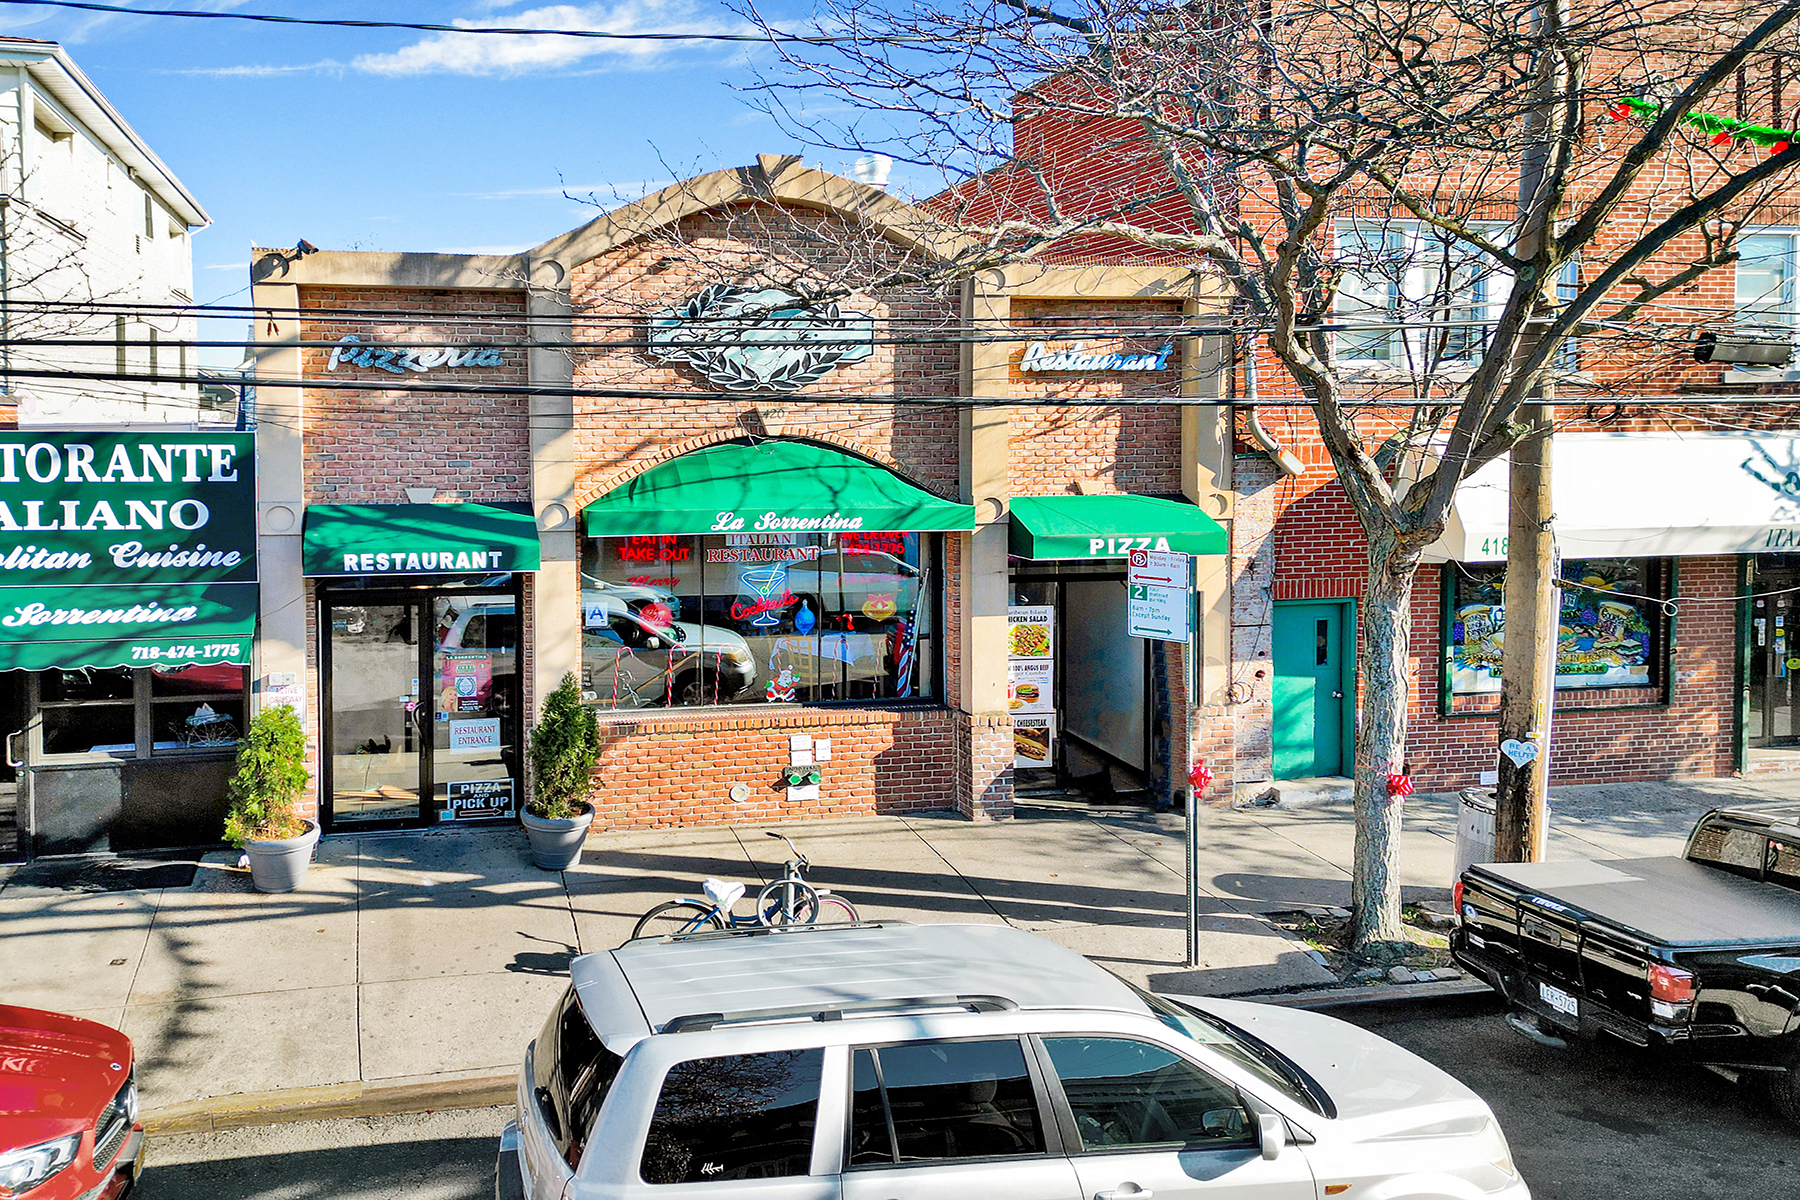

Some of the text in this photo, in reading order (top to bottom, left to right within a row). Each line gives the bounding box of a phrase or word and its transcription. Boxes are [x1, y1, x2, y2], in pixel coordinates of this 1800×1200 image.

[327, 335, 504, 374] Pizzeria
[1020, 341, 1174, 371] Restaurant
[763, 408, 785, 420] 420
[0, 442, 238, 483] TORANTE
[710, 511, 864, 531] La Sorrentina
[632, 535, 678, 545] EAT IN
[730, 534, 793, 545] ITALIAN
[863, 532, 910, 540] DELIVER
[1766, 528, 1800, 548] ITA
[1089, 536, 1171, 555] PIZZA
[108, 540, 242, 568] Cuisine
[343, 551, 503, 572] RESTAURANT
[619, 547, 690, 561] TAKE OUT
[706, 547, 820, 563] RESTAURANT
[1134, 585, 1144, 600] 2
[589, 604, 604, 620] A
[731, 589, 800, 620] Cocktails
[2, 602, 197, 627] Sorrentina
[131, 643, 241, 660] 718-474-1775
[454, 725, 497, 736] RESTAURANT
[458, 735, 493, 746] ENTRANCE
[460, 782, 501, 794] PIZZA
[453, 796, 509, 809] PICK UP
